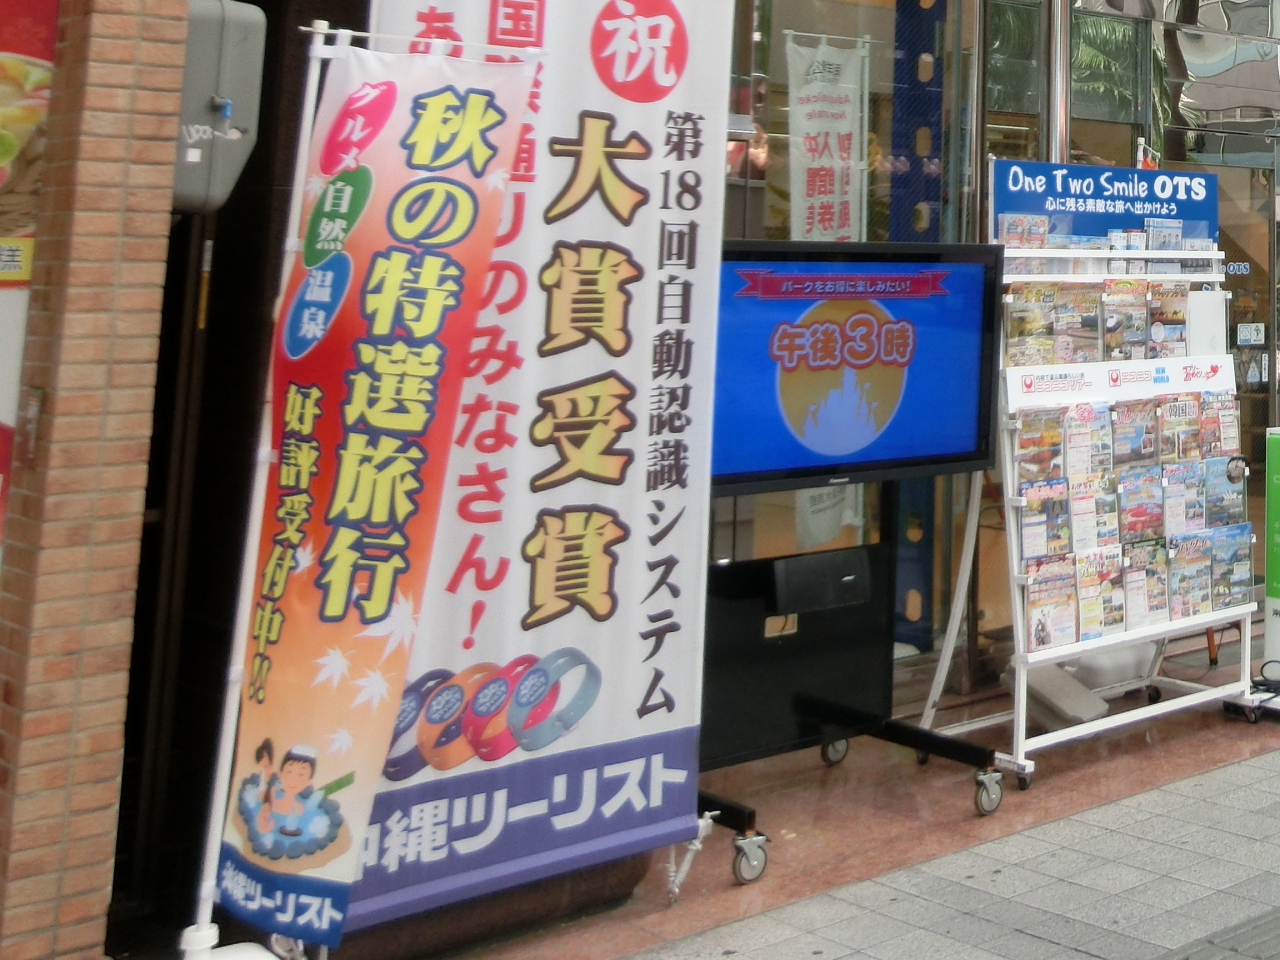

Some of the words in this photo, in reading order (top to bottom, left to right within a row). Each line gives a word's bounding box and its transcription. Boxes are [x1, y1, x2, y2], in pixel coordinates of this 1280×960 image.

[338, 83, 386, 170] グルメ
[1008, 165, 1046, 193] One
[1053, 168, 1094, 196] Two
[1100, 172, 1149, 198] Smile
[1153, 175, 1206, 200] OTS
[1045, 197, 1178, 215] 心に残る素敵な旅へ出かけよう
[317, 181, 354, 250] 自然
[782, 280, 911, 293] パークをお得に楽しみたい!
[1227, 262, 1250, 275] OTS
[298, 269, 333, 339] 温泉
[316, 84, 507, 623] 秋の特選旅行
[773, 312, 913, 369] 午後3時
[522, 109, 653, 631] 大賞受賞
[1153, 375, 1170, 384] WORLD
[1155, 367, 1166, 375] NEW
[636, 111, 705, 720] 第18回自動認識システム
